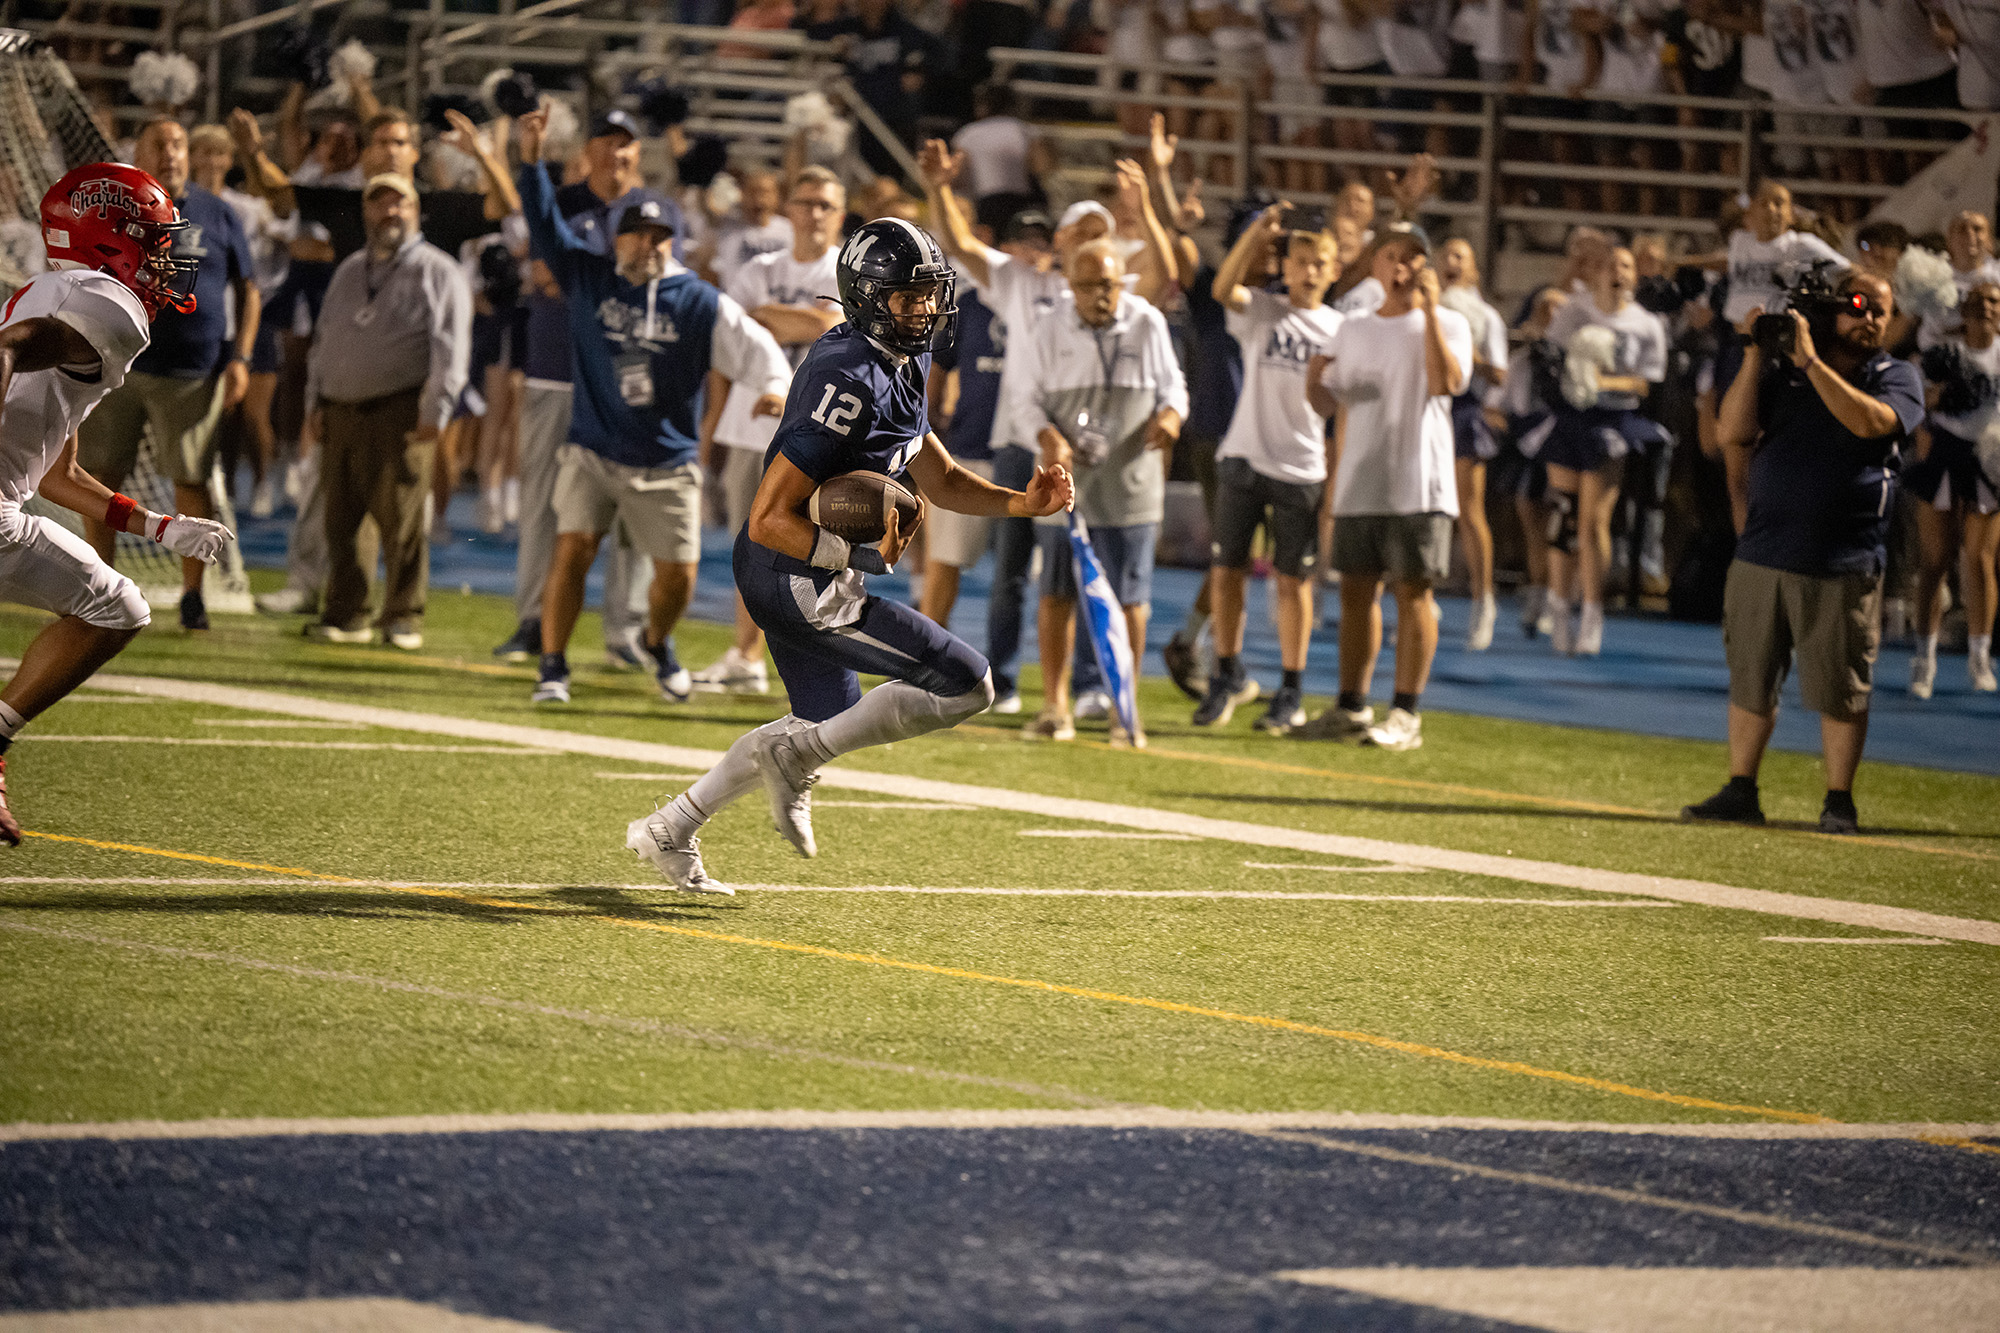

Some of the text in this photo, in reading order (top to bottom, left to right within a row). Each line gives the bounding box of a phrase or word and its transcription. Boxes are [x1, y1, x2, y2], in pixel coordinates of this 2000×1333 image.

[71, 185, 141, 219] Chardon
[840, 229, 879, 272] M
[811, 383, 863, 436] 12
[830, 502, 872, 514] Wilson
[648, 822, 676, 852] NIKE
